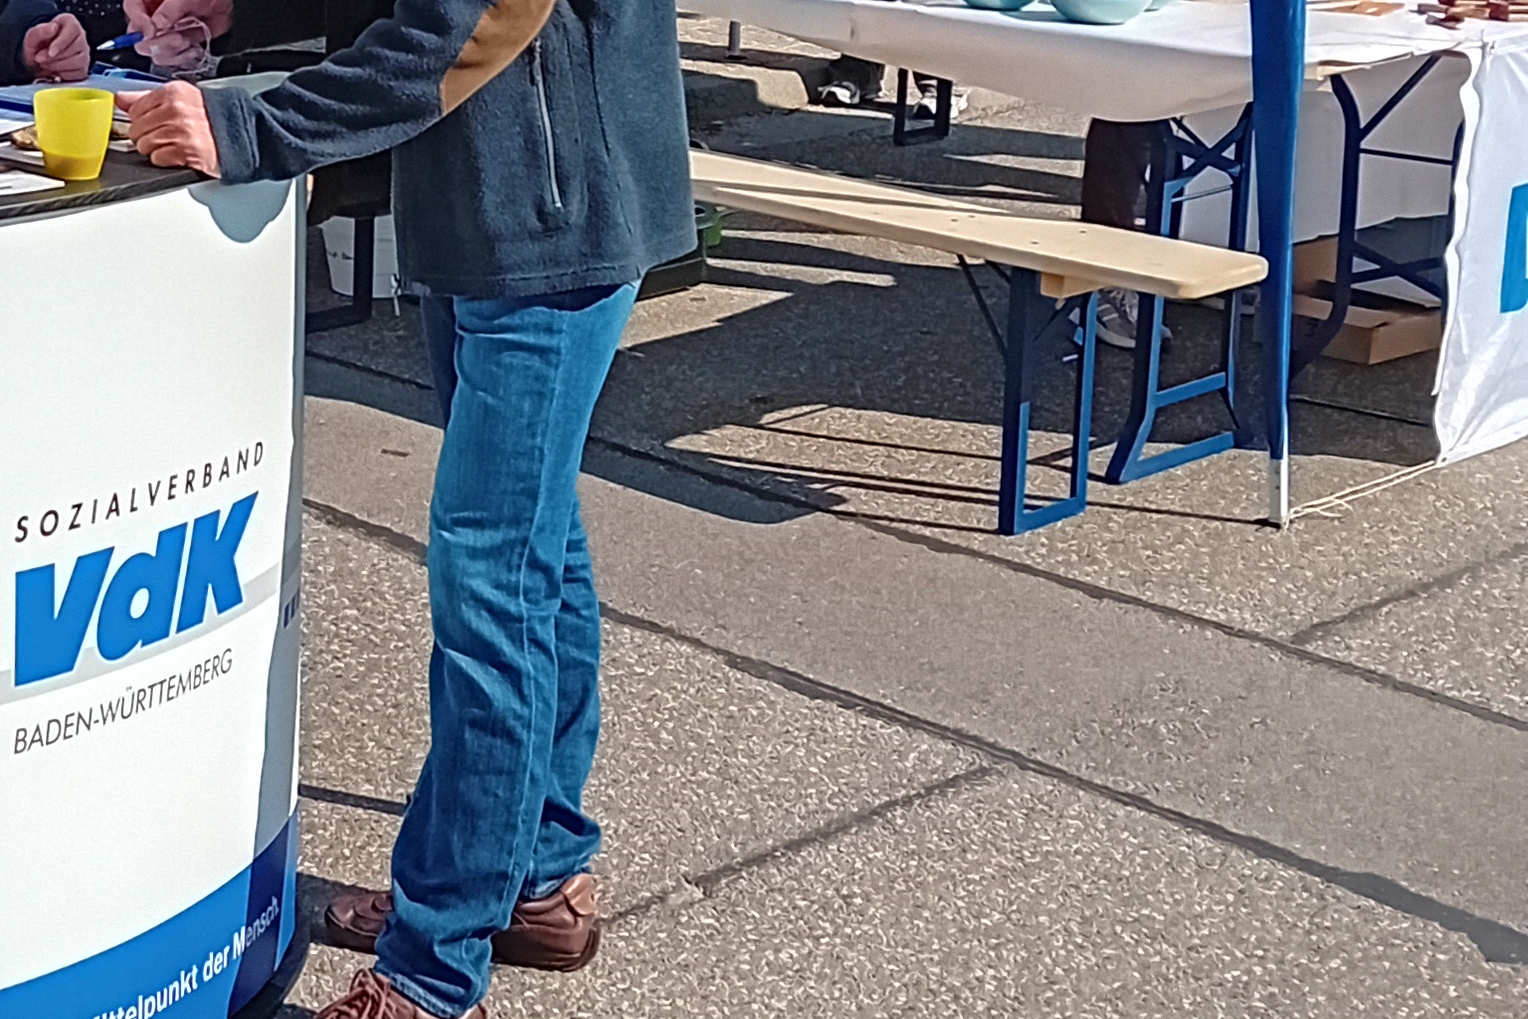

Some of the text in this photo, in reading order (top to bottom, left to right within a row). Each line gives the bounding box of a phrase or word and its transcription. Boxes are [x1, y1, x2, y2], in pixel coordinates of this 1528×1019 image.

[14, 441, 264, 543] SOZIALVERBAND
[14, 490, 259, 688] VdK
[13, 647, 234, 755] BADEN-WÜRTTEMBERG
[202, 945, 229, 982] der
